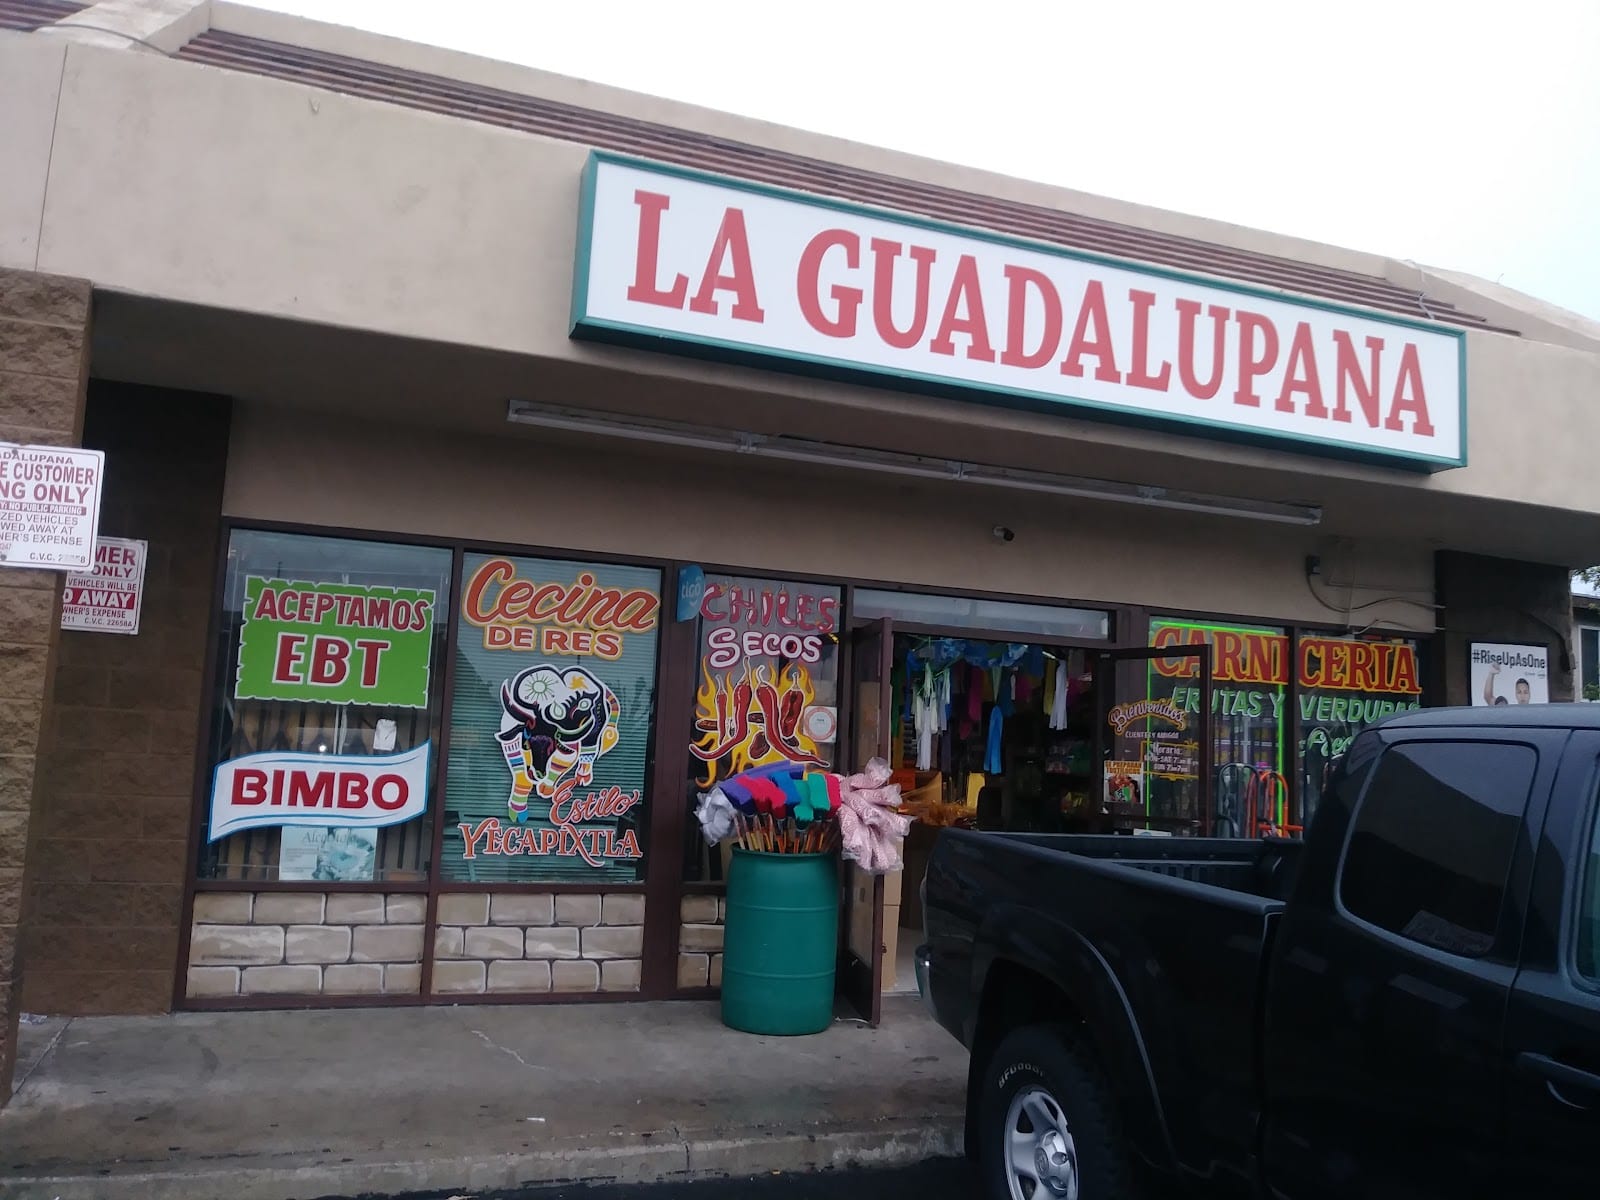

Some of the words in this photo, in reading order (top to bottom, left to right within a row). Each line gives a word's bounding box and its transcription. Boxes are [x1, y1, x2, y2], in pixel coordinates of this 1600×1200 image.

[627, 189, 764, 323] LA
[797, 229, 1435, 438] GUADALUPANA
[0, 451, 73, 465] DALUPANA
[13, 462, 94, 485] CUSTOMER
[34, 483, 89, 504] ONLY
[9, 502, 21, 510] NO
[22, 503, 49, 512] PUBLIC
[50, 504, 82, 514] PARKING
[26, 514, 78, 526] VEHICLES
[28, 524, 57, 534] AWAY
[61, 526, 74, 535] AT
[33, 534, 83, 546] EXPENSE
[91, 565, 133, 578] ONLY
[68, 578, 104, 588] VEHICLES
[107, 581, 125, 590] WILL
[460, 557, 661, 633] Cecina
[77, 590, 132, 608] AWAY
[254, 588, 430, 631] ACEPTAMOS
[700, 583, 841, 633] CHILES
[92, 608, 126, 618] EXPENSE
[486, 626, 534, 649] DE
[544, 630, 622, 658] RES
[272, 632, 391, 689] EBT
[1472, 648, 1546, 668] #RiseUpAsOne
[1269, 692, 1286, 718] Y
[1109, 699, 1186, 734] Bienvenidos
[231, 767, 409, 811] BIMBO
[548, 778, 640, 828] Estilo
